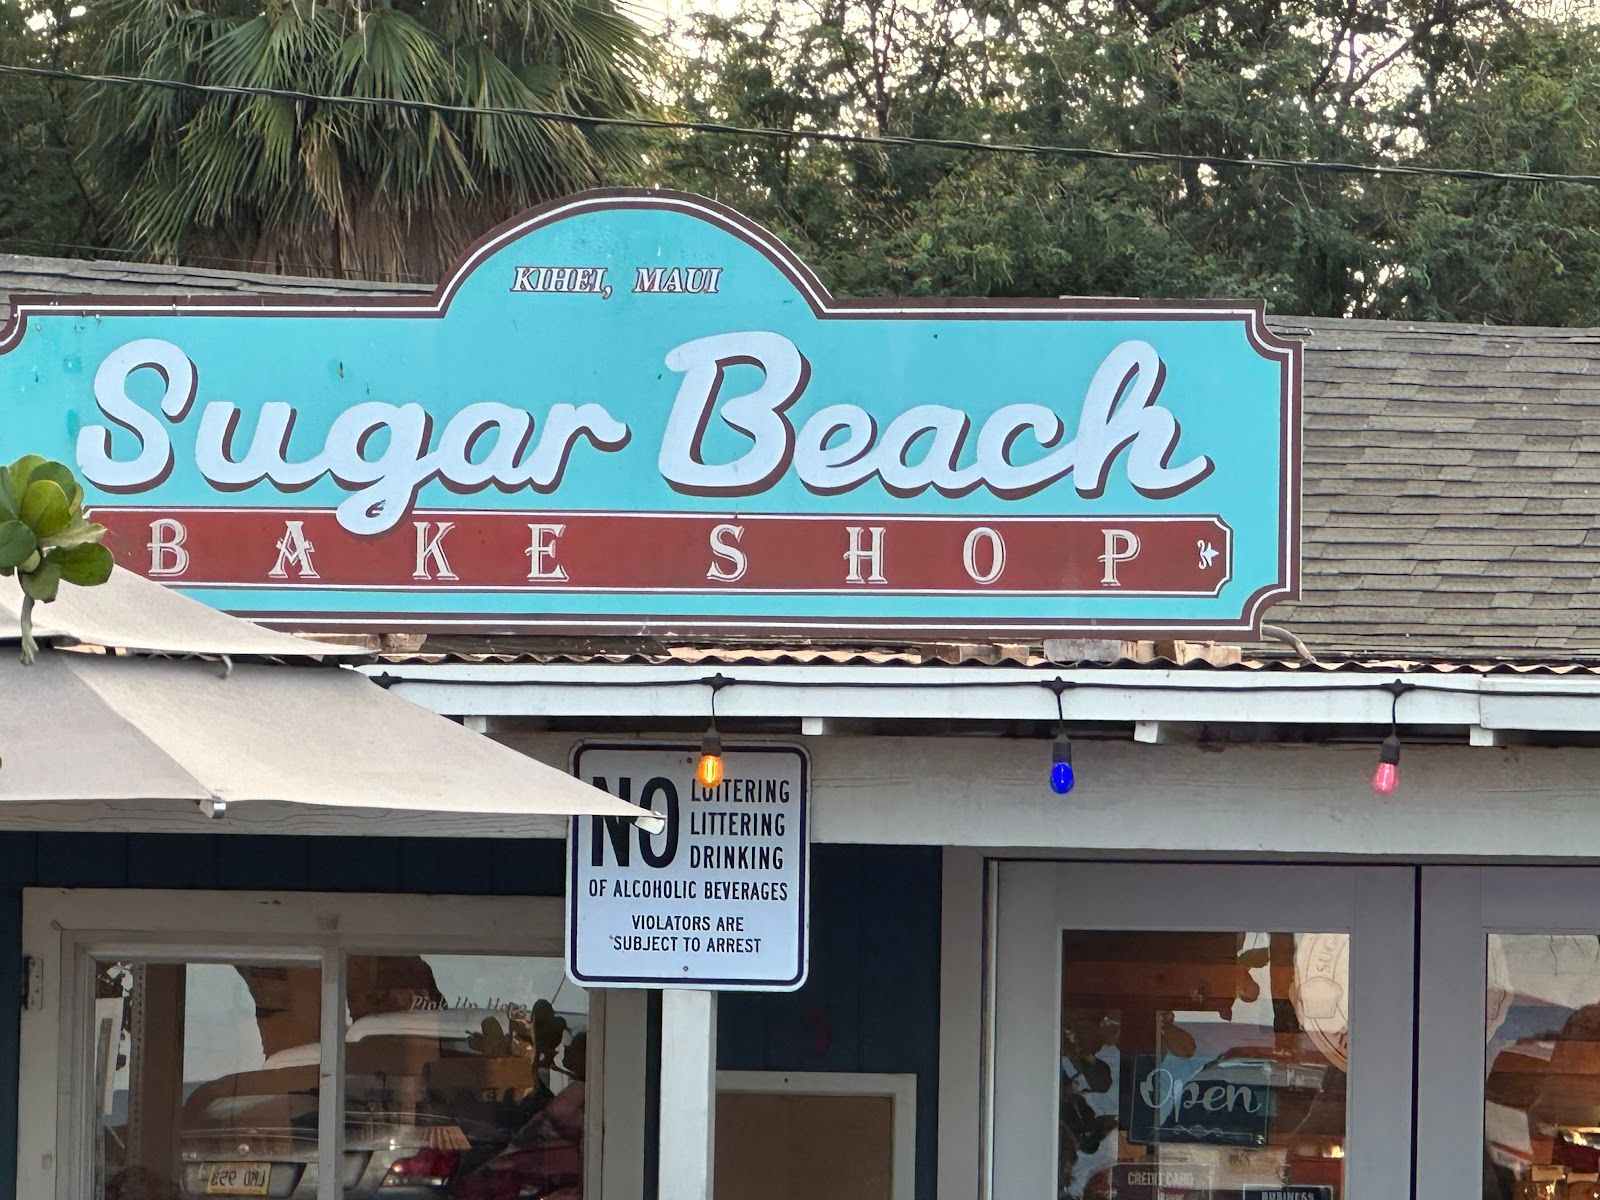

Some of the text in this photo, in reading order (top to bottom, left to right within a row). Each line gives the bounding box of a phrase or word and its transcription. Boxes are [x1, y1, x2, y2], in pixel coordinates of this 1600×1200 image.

[510, 267, 723, 300] KIHEI, MAUI
[76, 331, 1215, 538] Sugar Beach
[147, 517, 1141, 588] BAKE SHOP
[591, 776, 679, 869] NO
[690, 811, 785, 837] LITTERING
[690, 845, 783, 870] DRINKING
[588, 879, 788, 901] OF ALCOHOLIC BEVERAGES
[632, 914, 744, 932] VIOLATORS ARE
[613, 935, 762, 953] SUBJECT TO ARREST
[1139, 1068, 1262, 1123] Open
